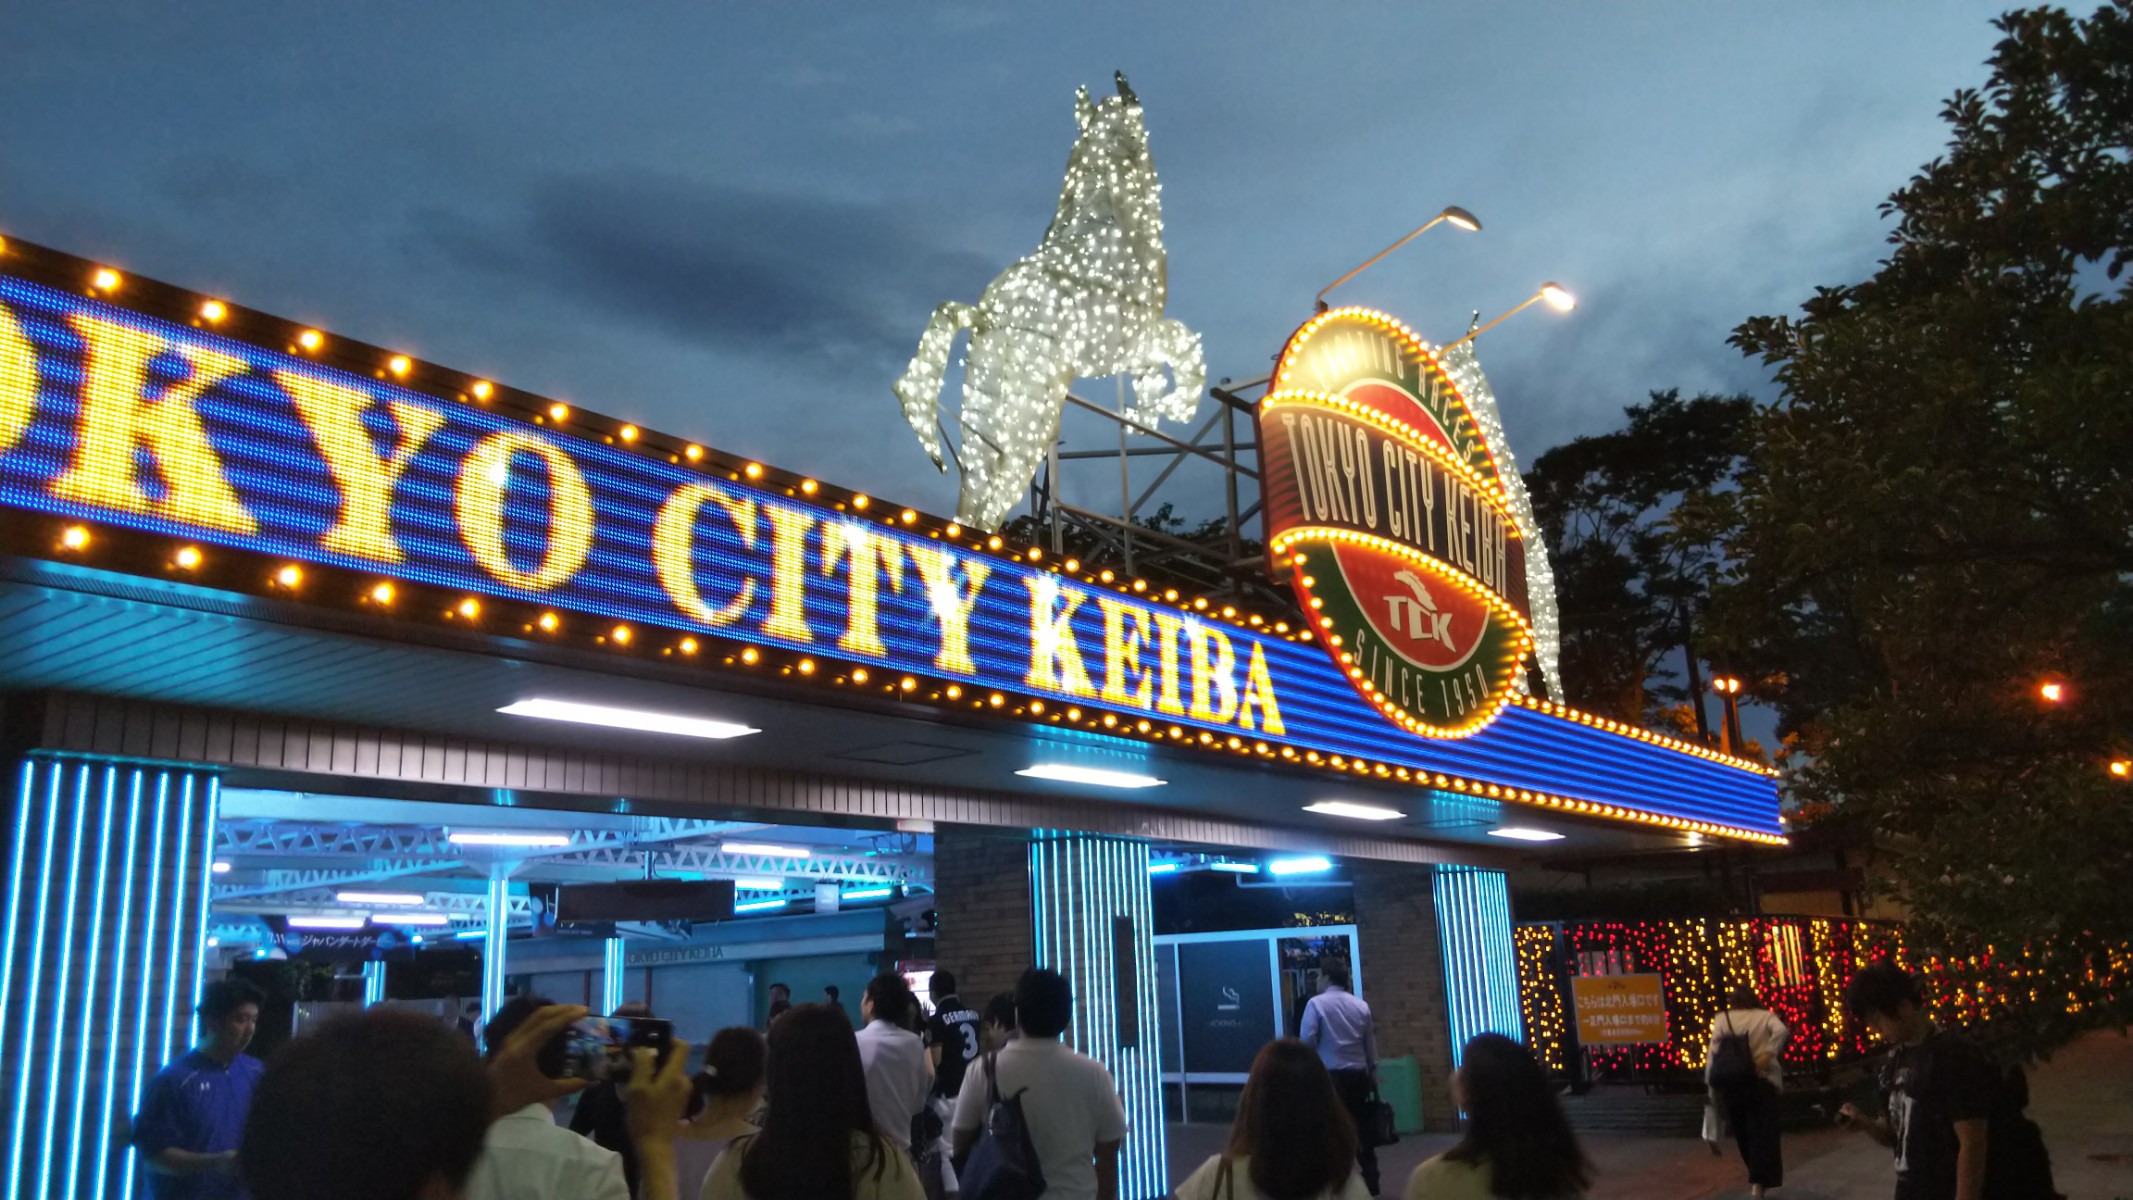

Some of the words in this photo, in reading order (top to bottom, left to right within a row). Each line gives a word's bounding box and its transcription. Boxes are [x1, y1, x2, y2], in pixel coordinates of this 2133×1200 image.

[1418, 363, 1474, 463] RACES
[0, 308, 595, 592] KYO
[650, 482, 991, 675] CITY
[1022, 574, 1286, 735] KEIBA
[1281, 412, 1378, 530] TOKYO
[1382, 438, 1434, 552] CITY
[1444, 471, 1507, 599] KEIBA
[1354, 628, 1426, 715] SINCE
[1440, 663, 1490, 718] 1950
[959, 1022, 979, 1060] 3
